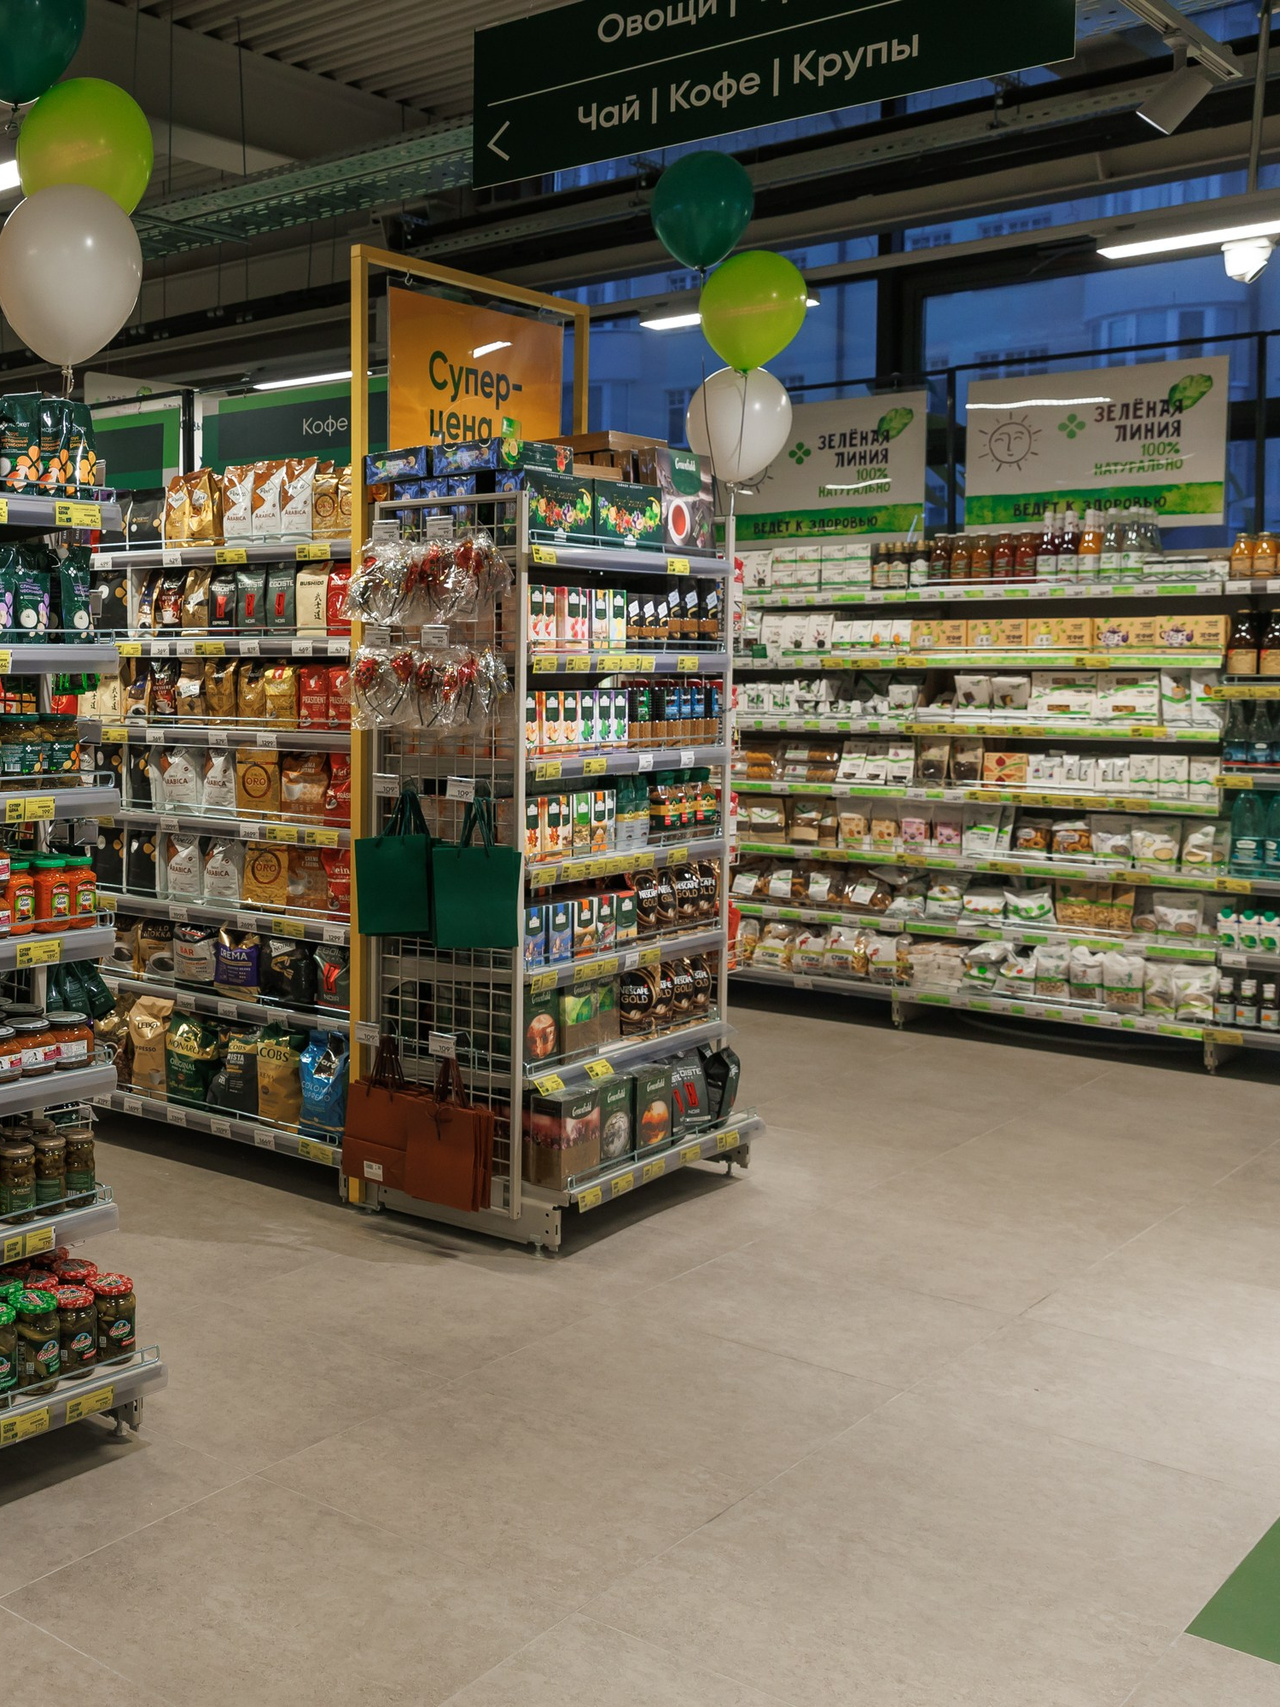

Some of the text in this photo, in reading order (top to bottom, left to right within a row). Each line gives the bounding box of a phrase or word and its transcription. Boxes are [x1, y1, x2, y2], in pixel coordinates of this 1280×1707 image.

[597, 0, 717, 43] Овощи
[578, 34, 919, 131] Чай Кофе Крупы
[429, 351, 523, 402] Супер-
[1094, 399, 1183, 422] ЗЕЛЁНАЯ
[302, 417, 348, 436] Кофе
[430, 408, 492, 442] цена
[1115, 420, 1181, 442] ЛИНИЯ
[818, 429, 890, 450] ЗЕЛЁНАЯ
[1141, 442, 1180, 456] 100%
[835, 448, 888, 468] ЛИНИЯ
[1094, 459, 1183, 475] НАТУРАЛЬНО
[857, 467, 888, 481] 100%
[753, 514, 878, 534] ВЕДЁТ К ЗДОРОВЬЮ
[245, 776, 267, 786] ORO
[256, 863, 277, 873] ORO
[677, 888, 698, 898] GOLD
[142, 930, 171, 938] MOKKA
[180, 946, 194, 956] BAR
[621, 995, 648, 1003] GOLD
